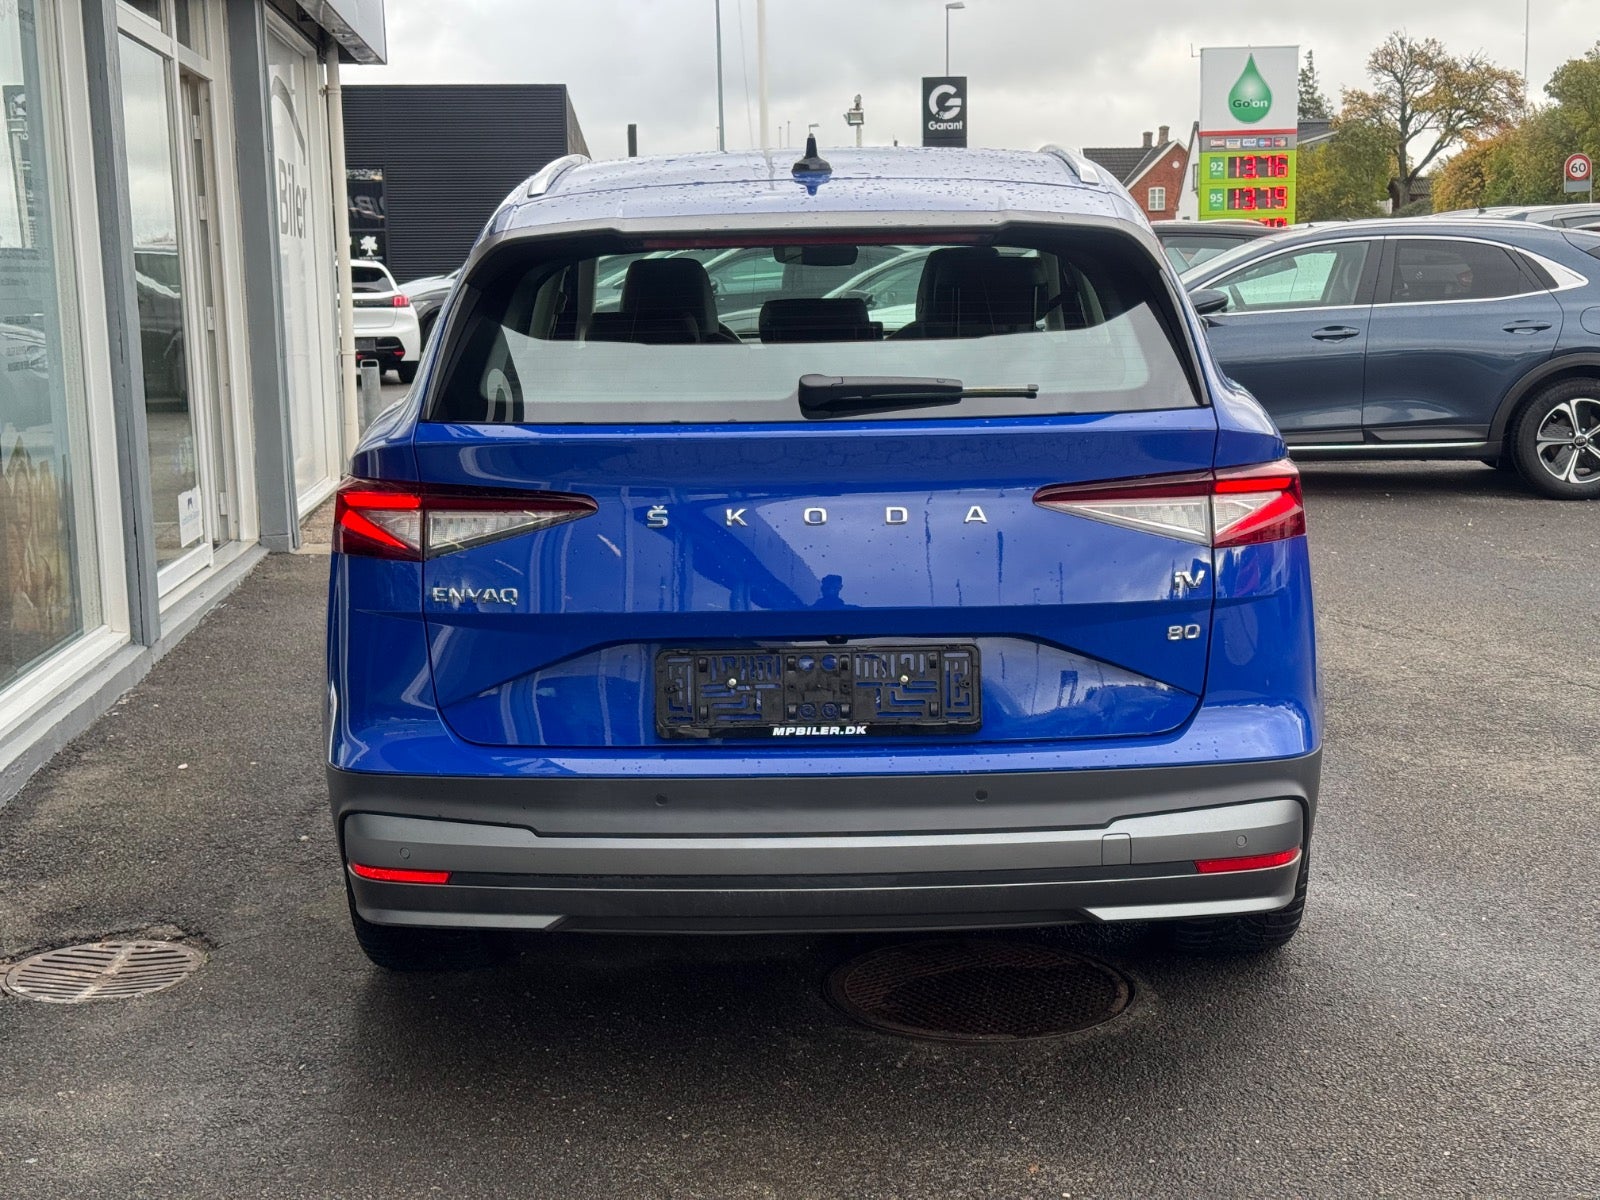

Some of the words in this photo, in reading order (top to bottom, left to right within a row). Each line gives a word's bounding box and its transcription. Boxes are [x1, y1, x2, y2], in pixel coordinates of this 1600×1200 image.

[928, 120, 963, 130] Garant
[1210, 161, 1224, 171] 92
[1235, 153, 1288, 178] 13.76
[1570, 162, 1587, 173] 60
[279, 158, 307, 239] Biler
[1209, 193, 1223, 203] 95
[1234, 186, 1287, 210] 13.79
[432, 587, 519, 606] ENYAQ
[1167, 624, 1201, 640] 80
[772, 725, 868, 737] MPBILER.DK
